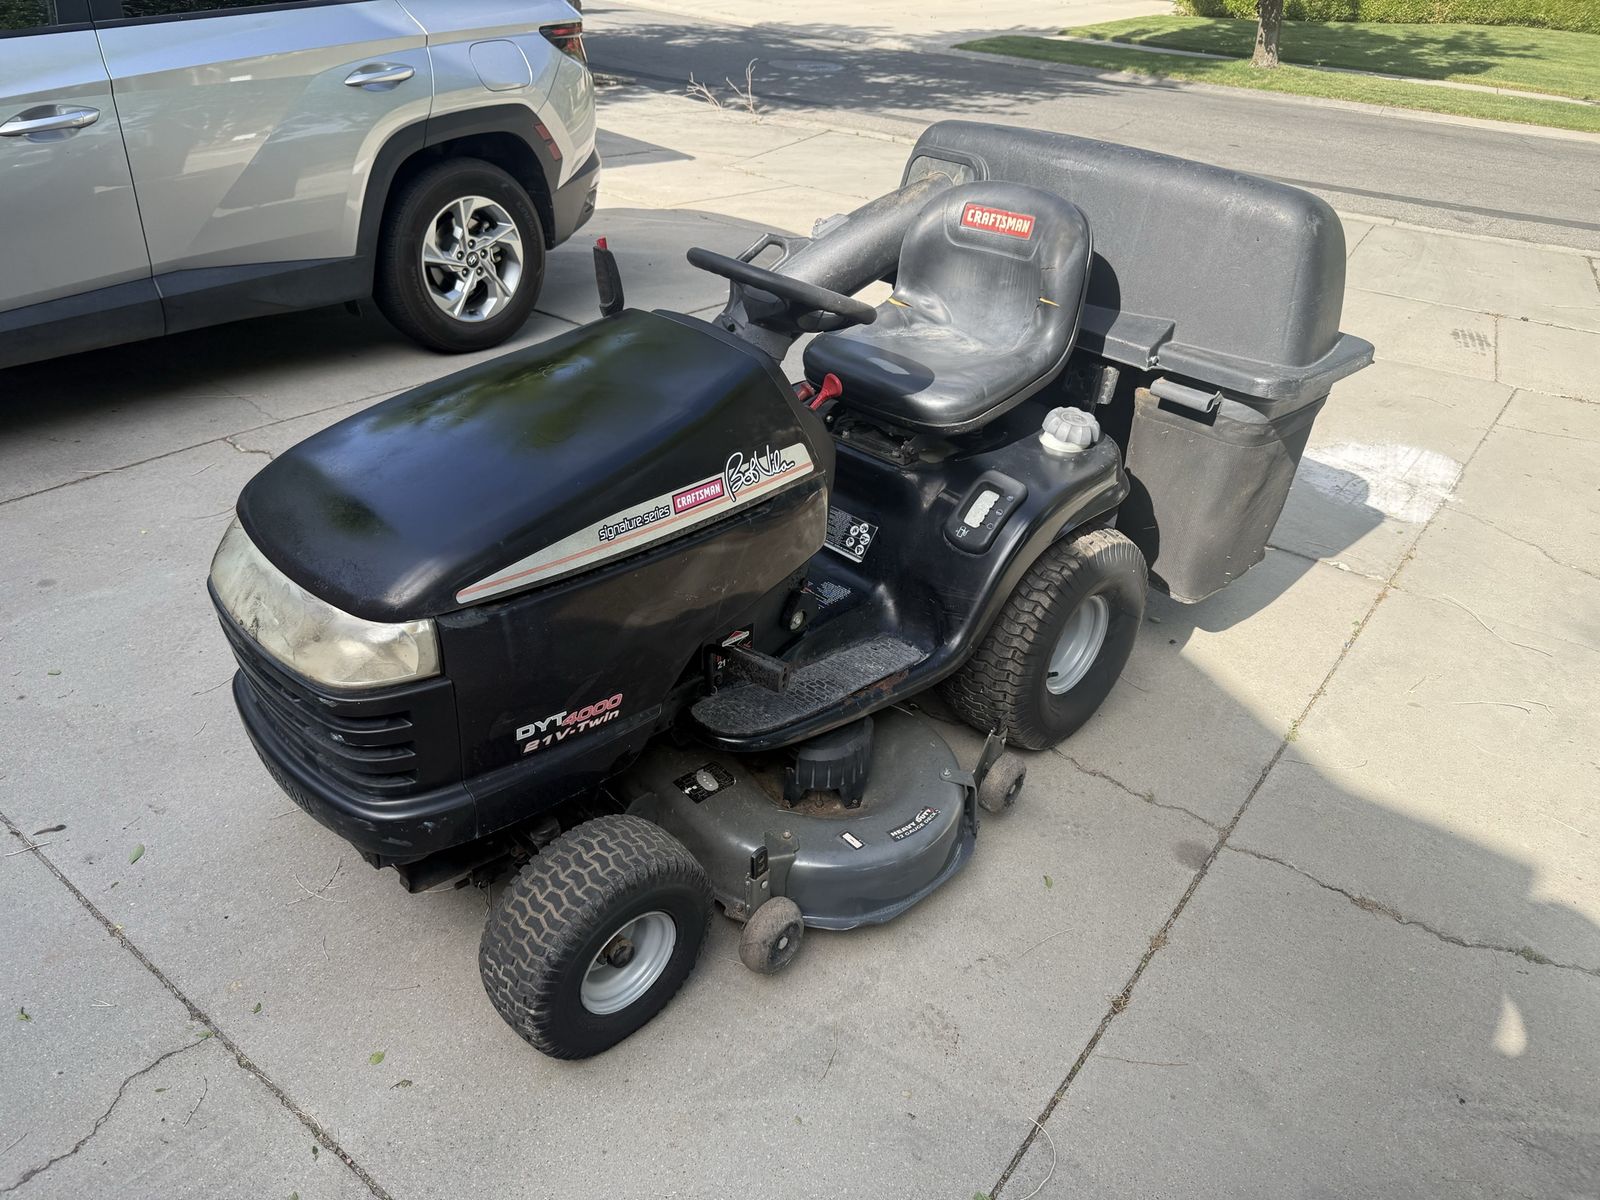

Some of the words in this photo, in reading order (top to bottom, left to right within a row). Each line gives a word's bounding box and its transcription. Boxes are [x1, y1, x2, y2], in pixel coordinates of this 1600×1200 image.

[966, 208, 1031, 234] CRAFTSMAN
[724, 452, 760, 502] Bob
[754, 445, 795, 476] Vila
[676, 483, 721, 508] CRAFTSMAN
[598, 516, 643, 541] signature
[643, 505, 671, 524] series
[890, 821, 916, 837] HEAVY
[904, 822, 925, 836] GAUGE
